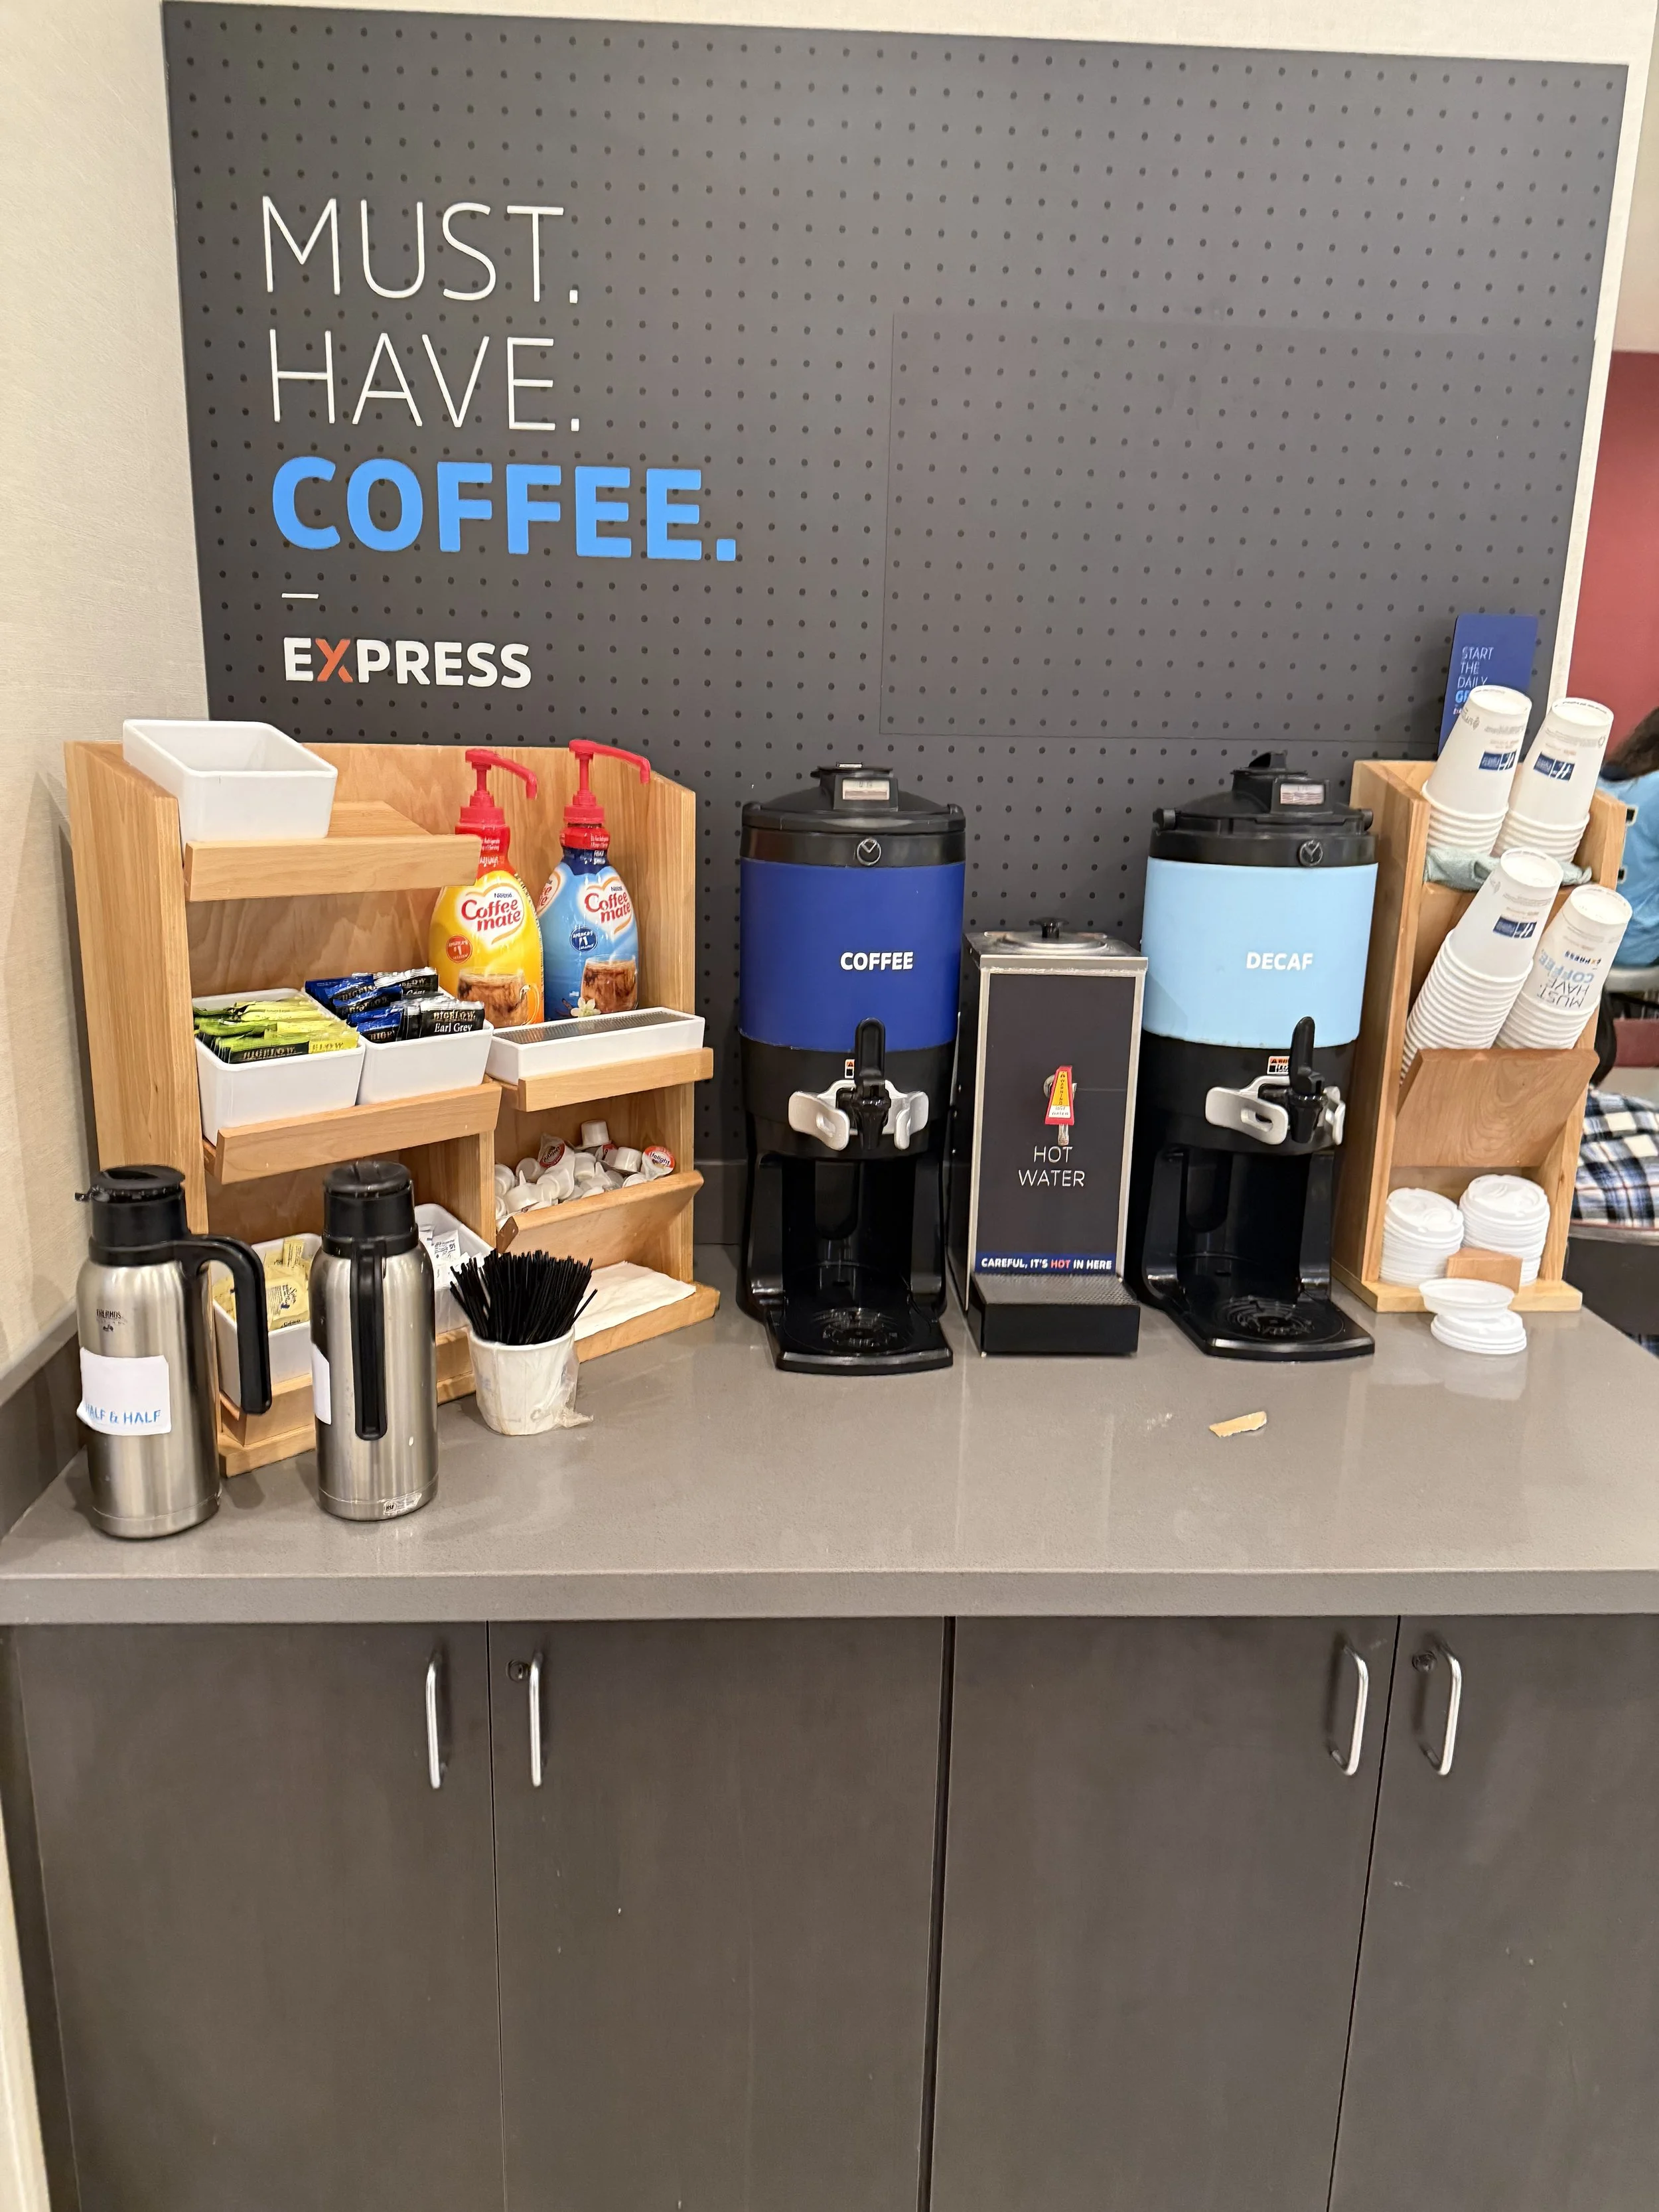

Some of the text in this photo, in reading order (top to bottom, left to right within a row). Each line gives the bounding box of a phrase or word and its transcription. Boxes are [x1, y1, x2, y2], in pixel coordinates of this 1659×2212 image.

[261, 194, 579, 305] MUST.
[269, 329, 580, 431] HAVE.
[272, 456, 737, 561] COFFEE.
[283, 636, 532, 689] EXPRESS
[1462, 646, 1494, 660] START
[1461, 661, 1480, 674] THE
[461, 899, 518, 921] Coffee
[584, 892, 628, 913] Coffee
[477, 910, 522, 932] mate
[600, 902, 631, 923] mate
[840, 952, 914, 971] COFFEE
[1246, 952, 1313, 971] DECAF
[435, 1023, 472, 1033] Earl Grey
[1033, 1145, 1073, 1163] HOT
[1018, 1169, 1086, 1187] WATER
[981, 1258, 1112, 1270] CAREFUL, IT'S HOT IN HERE
[109, 1411, 119, 1424] &
[123, 1409, 161, 1424] HALF
